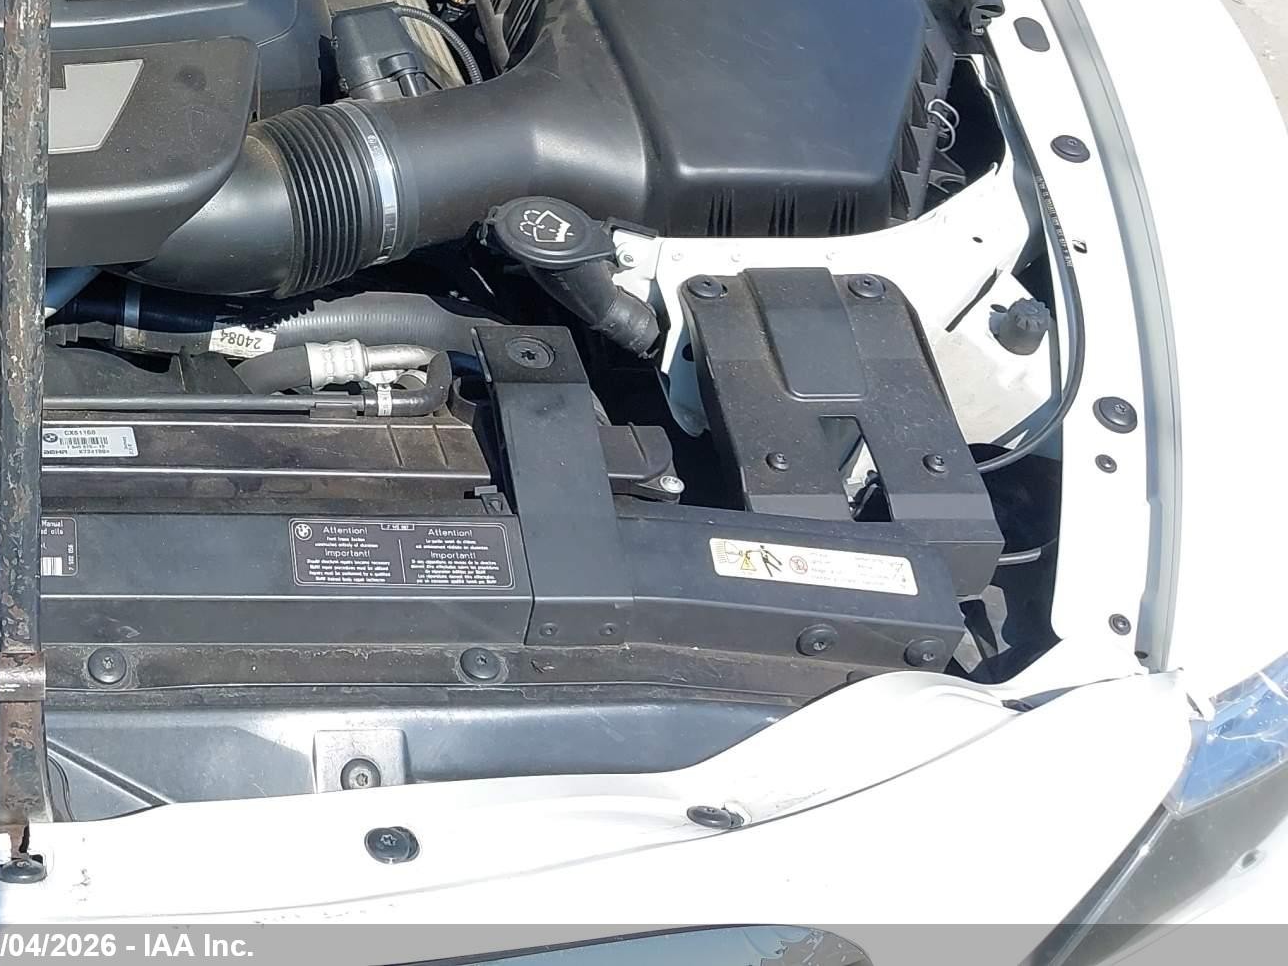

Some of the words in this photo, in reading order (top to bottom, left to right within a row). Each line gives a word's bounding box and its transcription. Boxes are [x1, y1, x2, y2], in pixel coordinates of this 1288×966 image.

[219, 329, 263, 350] 24084
[322, 526, 368, 535] Attention!
[427, 528, 473, 537] Attention!
[324, 548, 370, 558] Important!
[430, 550, 476, 560] Important!
